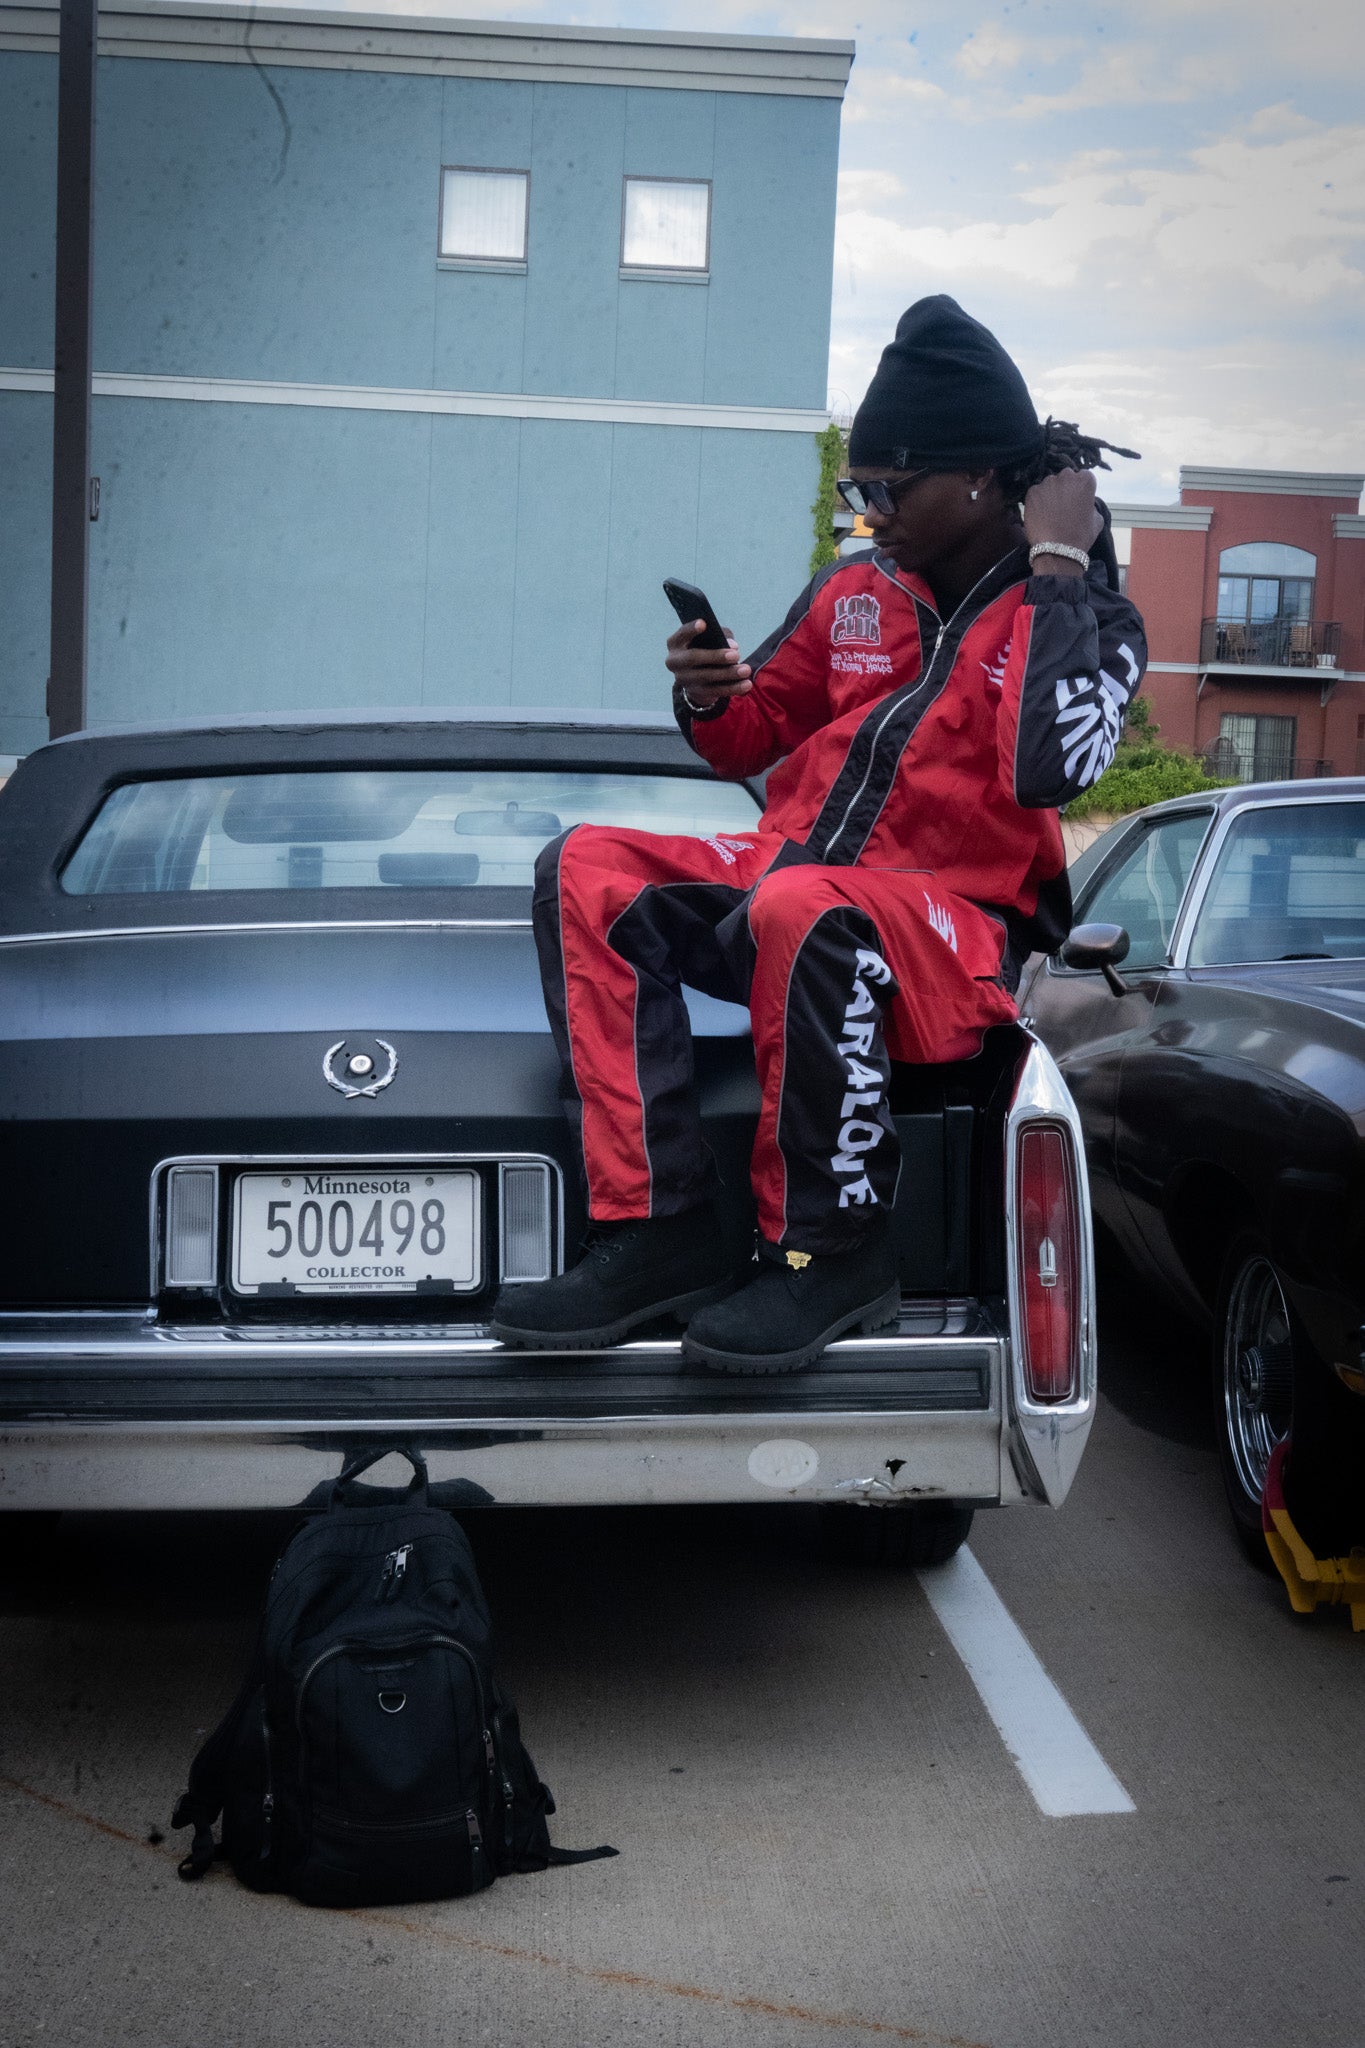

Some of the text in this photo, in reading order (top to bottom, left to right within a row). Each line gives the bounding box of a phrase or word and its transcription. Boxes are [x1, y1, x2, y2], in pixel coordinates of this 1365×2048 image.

[834, 593, 880, 622] LOVE
[830, 615, 881, 646] CLUB
[303, 1176, 412, 1196] Minnesota
[266, 1199, 446, 1258] 500498
[306, 1265, 407, 1279] COLLECTOR
